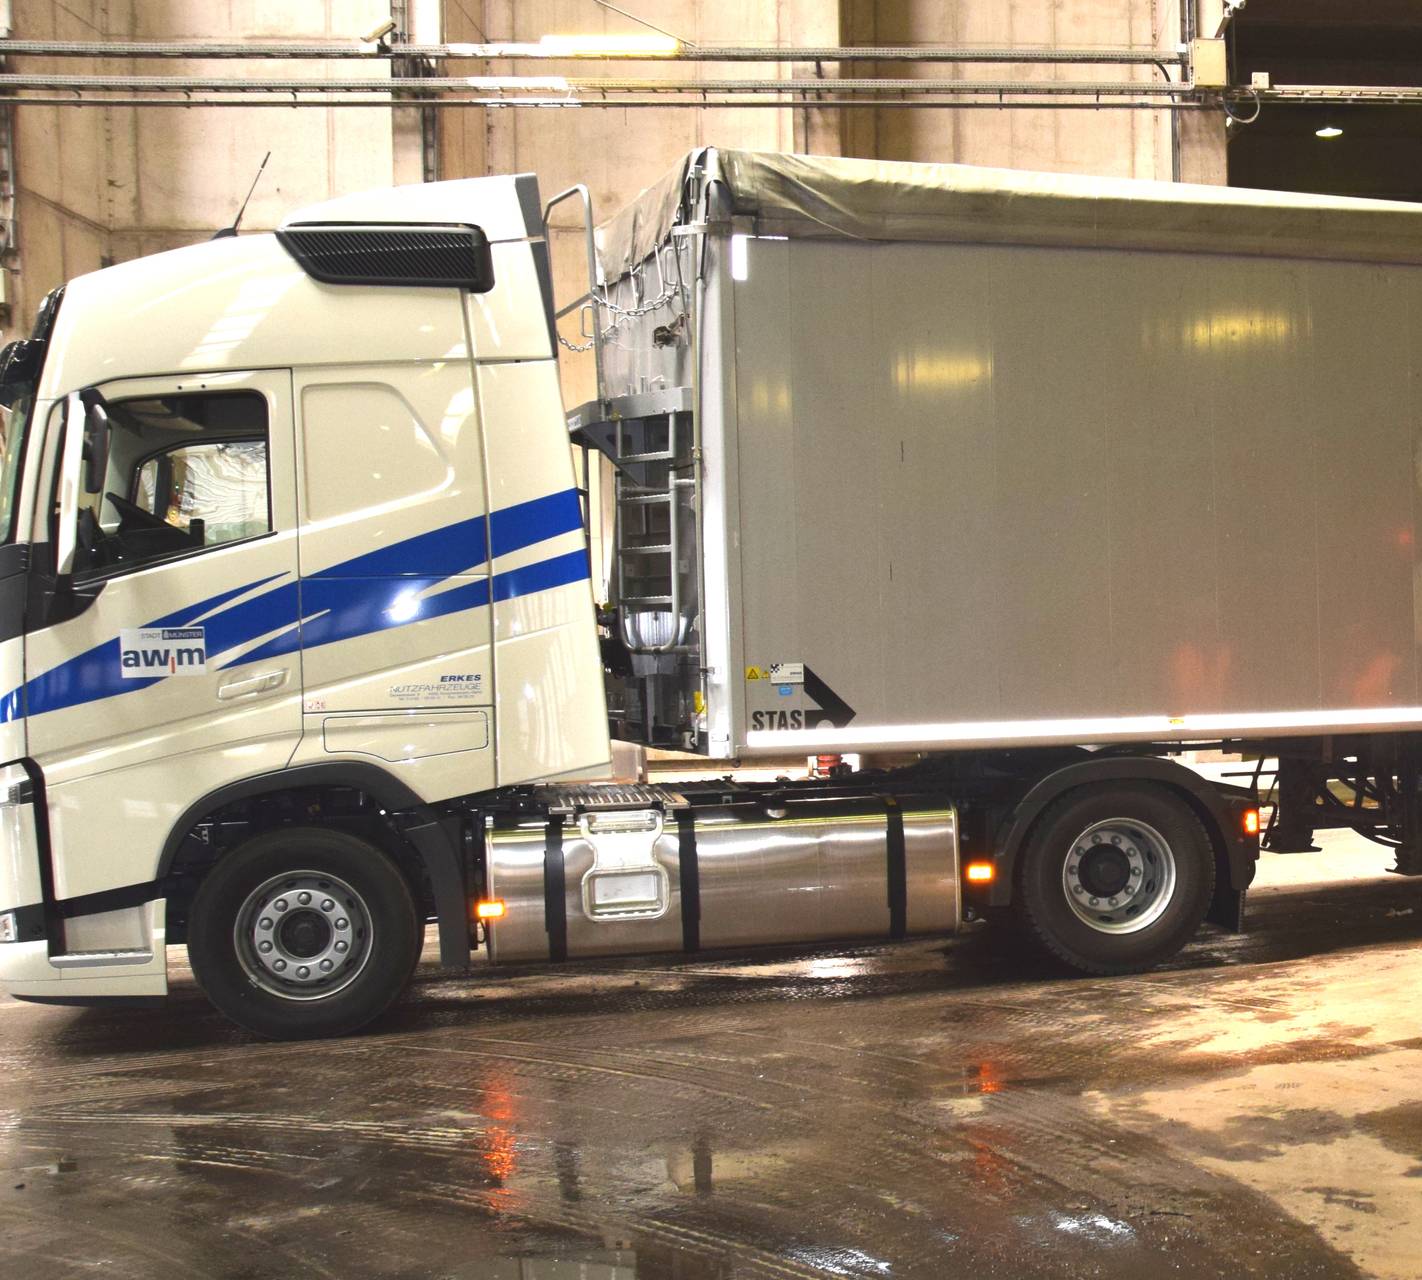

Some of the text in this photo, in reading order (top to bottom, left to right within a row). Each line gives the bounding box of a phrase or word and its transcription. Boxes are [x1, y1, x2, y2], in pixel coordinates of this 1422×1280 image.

[440, 674, 481, 683] ERKES
[390, 682, 481, 693] NUTZFAHRZEUGE
[751, 709, 803, 731] STAS
